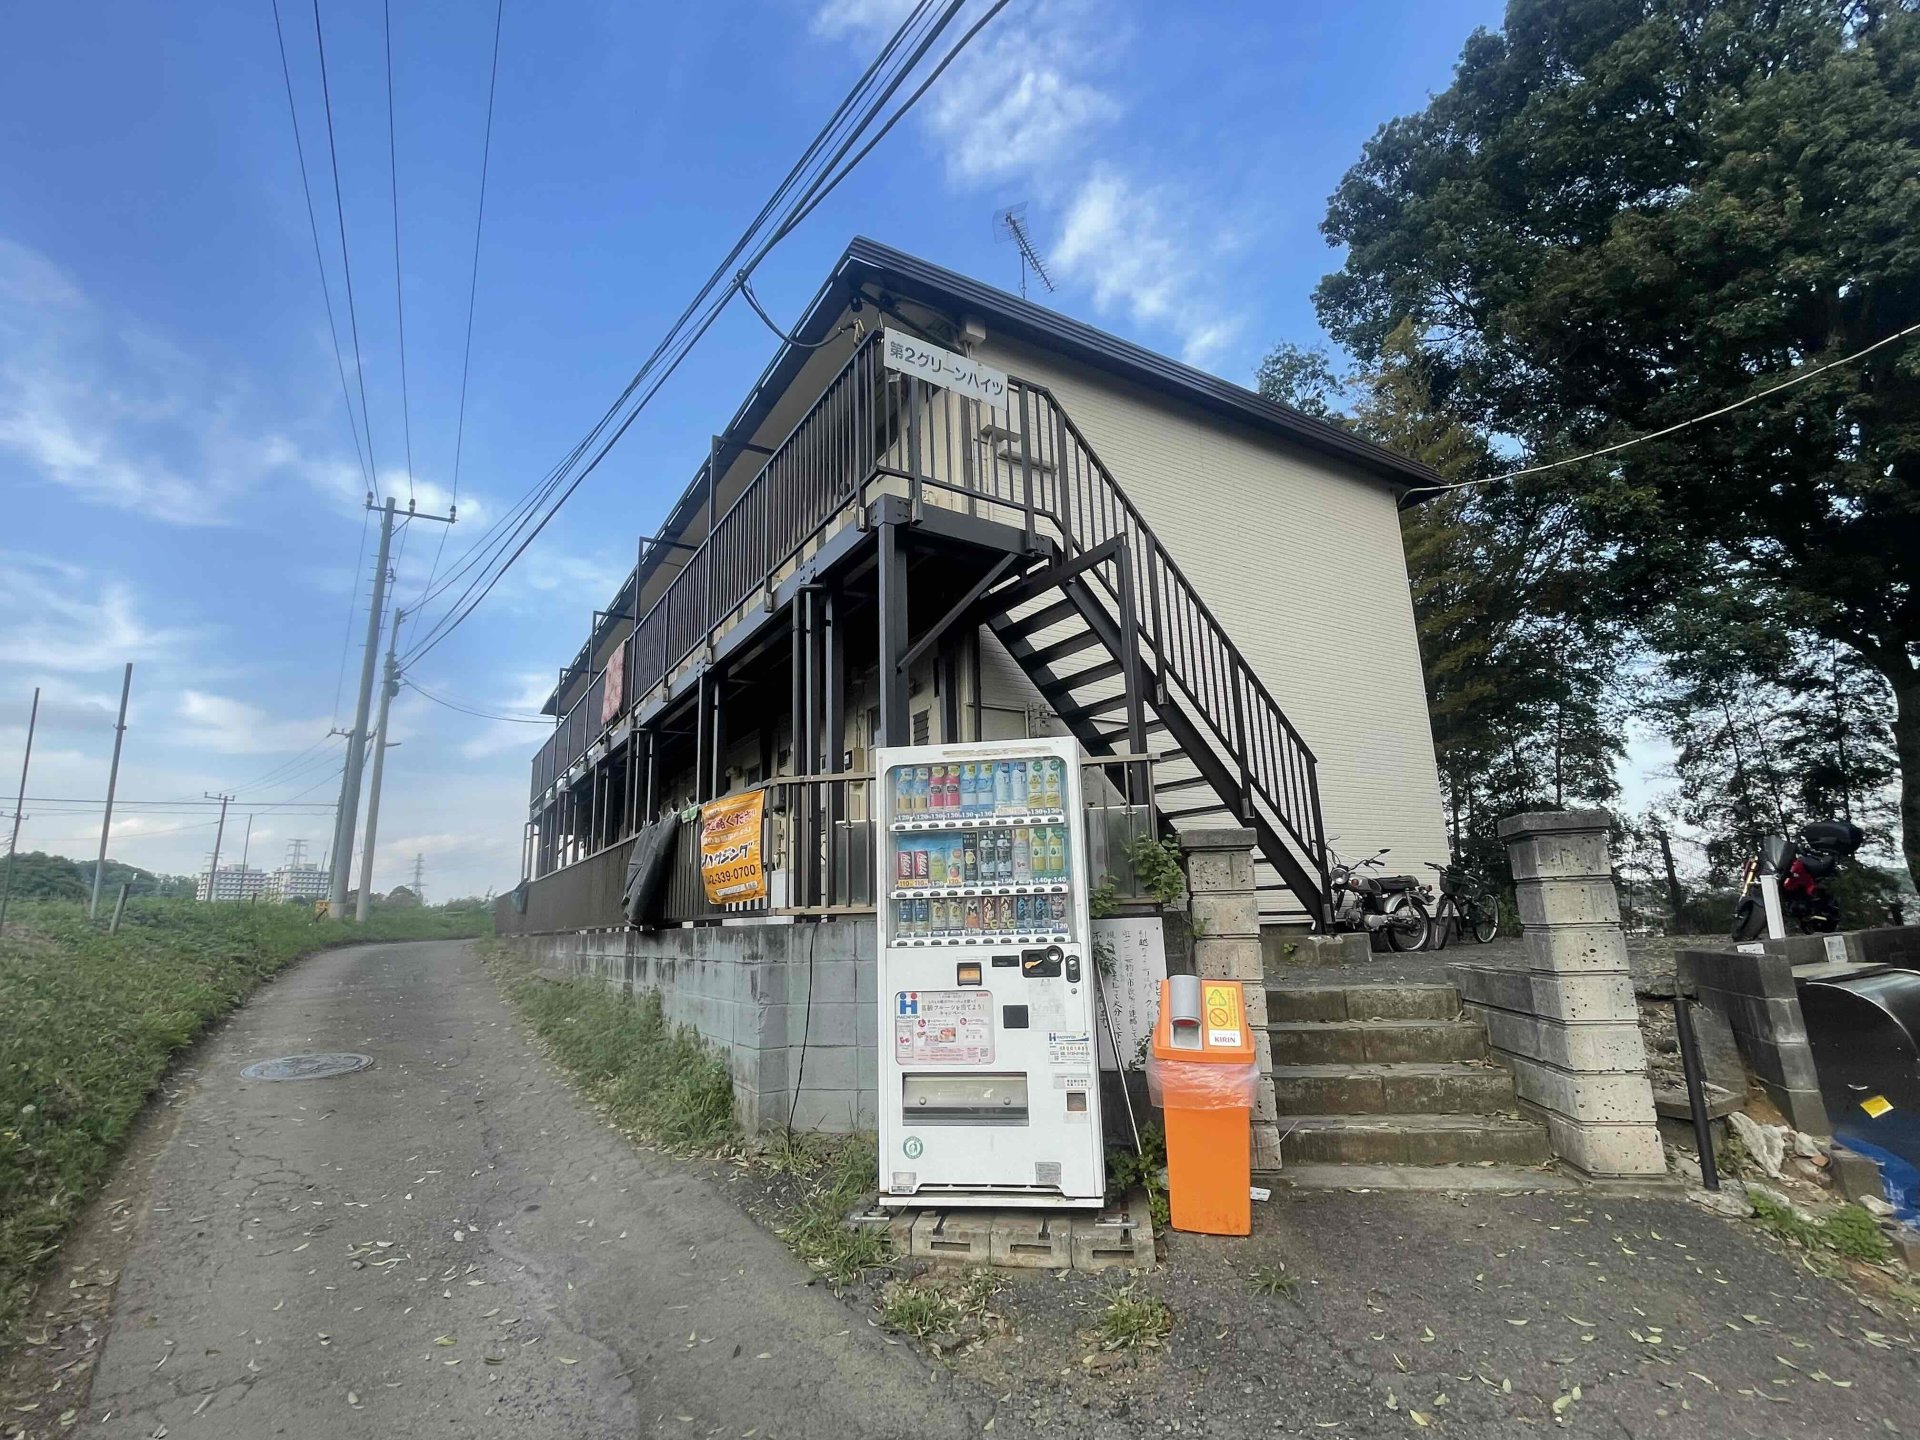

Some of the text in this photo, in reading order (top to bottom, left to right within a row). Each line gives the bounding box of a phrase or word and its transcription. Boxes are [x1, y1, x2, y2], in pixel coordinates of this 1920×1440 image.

[890, 341, 1003, 395] 第2グリーンハイツ
